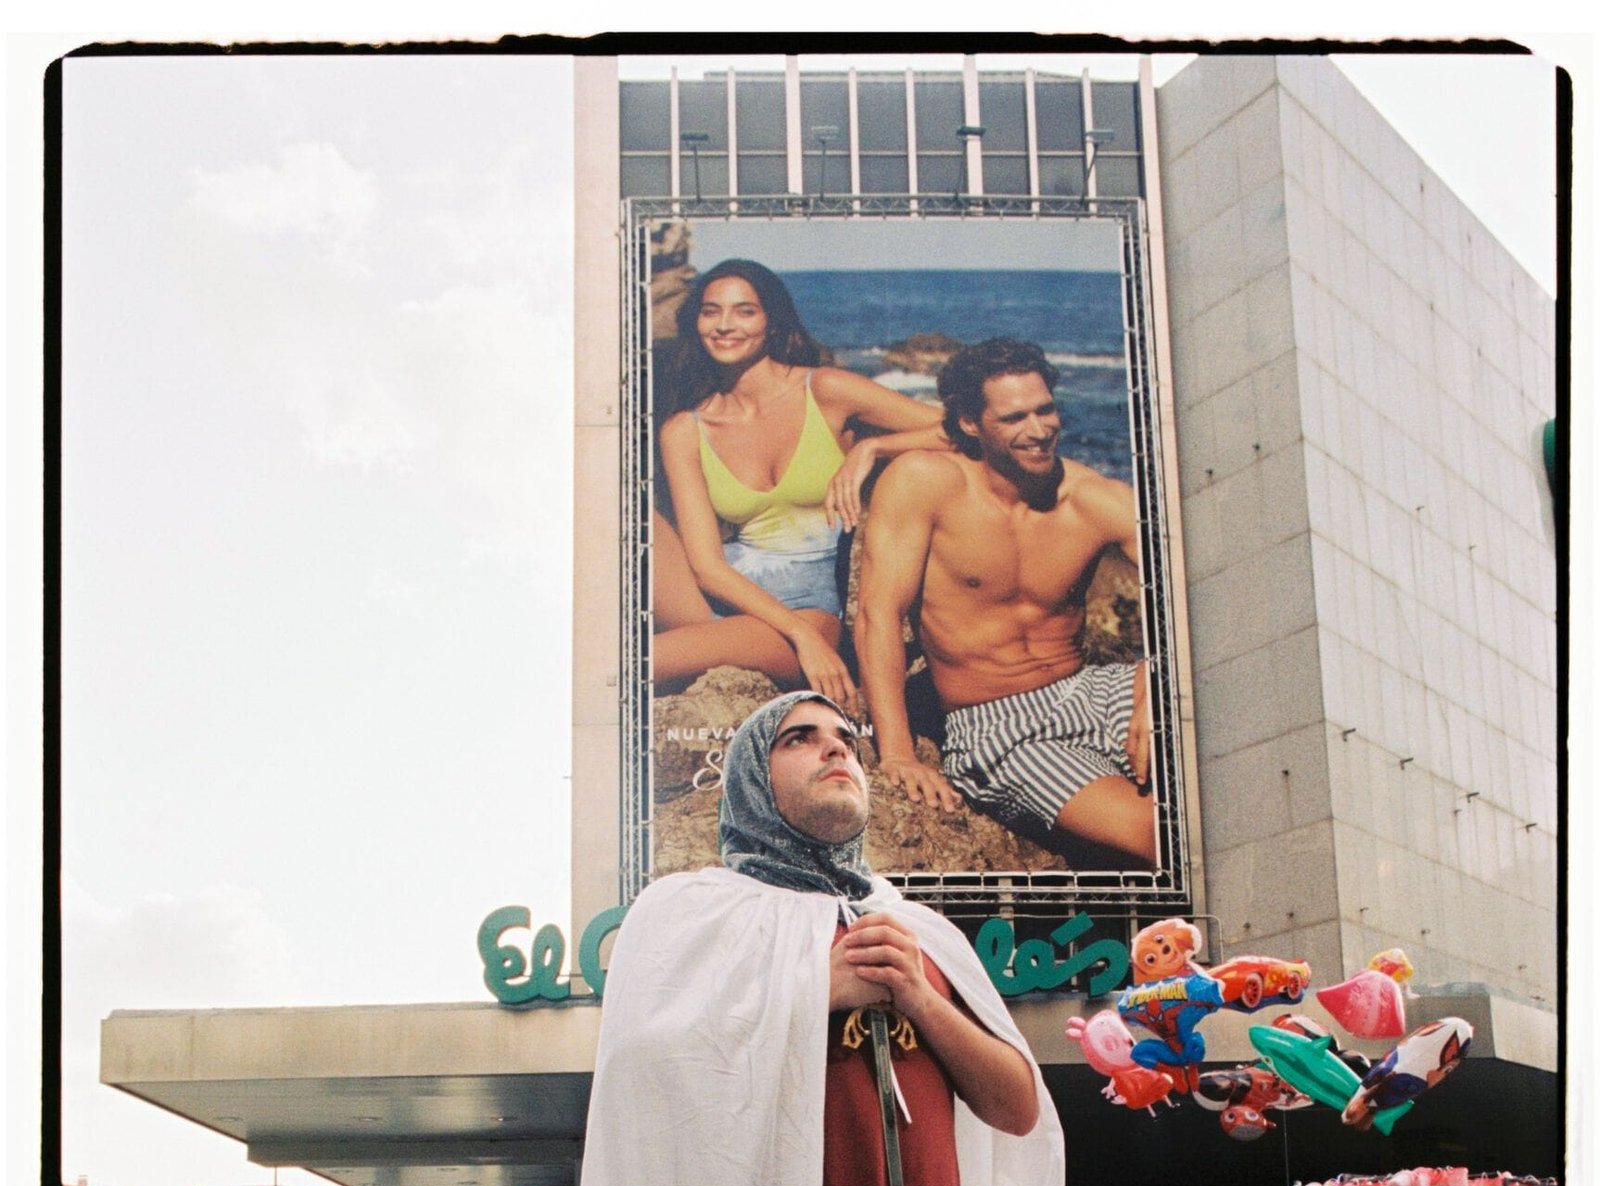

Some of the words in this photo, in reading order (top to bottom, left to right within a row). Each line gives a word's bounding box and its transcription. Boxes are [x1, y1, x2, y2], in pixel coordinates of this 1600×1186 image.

[667, 726, 736, 741] NUEVA
[477, 905, 571, 1003] El
[975, 910, 1130, 997] lés
